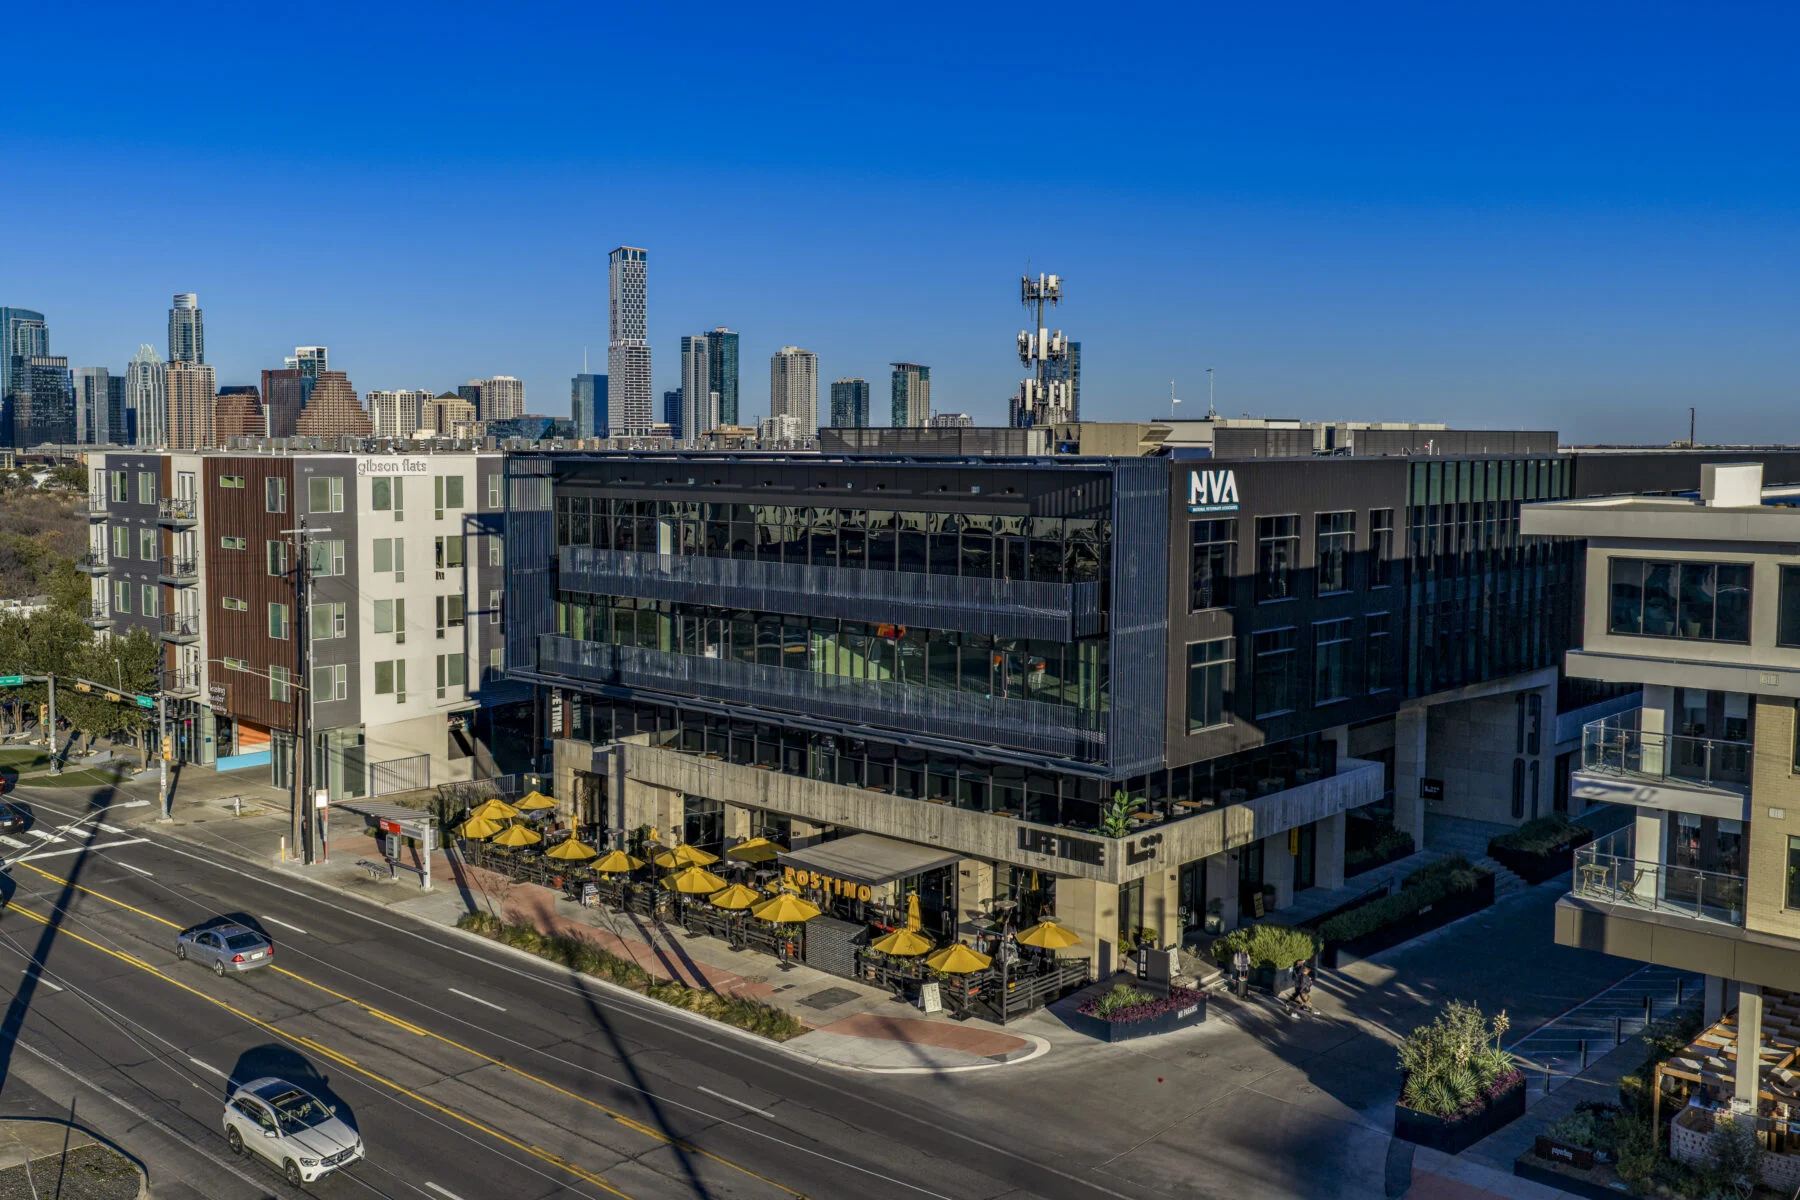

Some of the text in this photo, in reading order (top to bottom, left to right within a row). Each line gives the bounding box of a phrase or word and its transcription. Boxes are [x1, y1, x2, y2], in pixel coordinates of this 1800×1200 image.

[358, 458, 427, 475] gibson flats
[1188, 469, 1240, 504] NVA
[1516, 692, 1542, 755] 13
[1017, 826, 1105, 867] LIFE TIME
[784, 866, 872, 902] POSTINO
